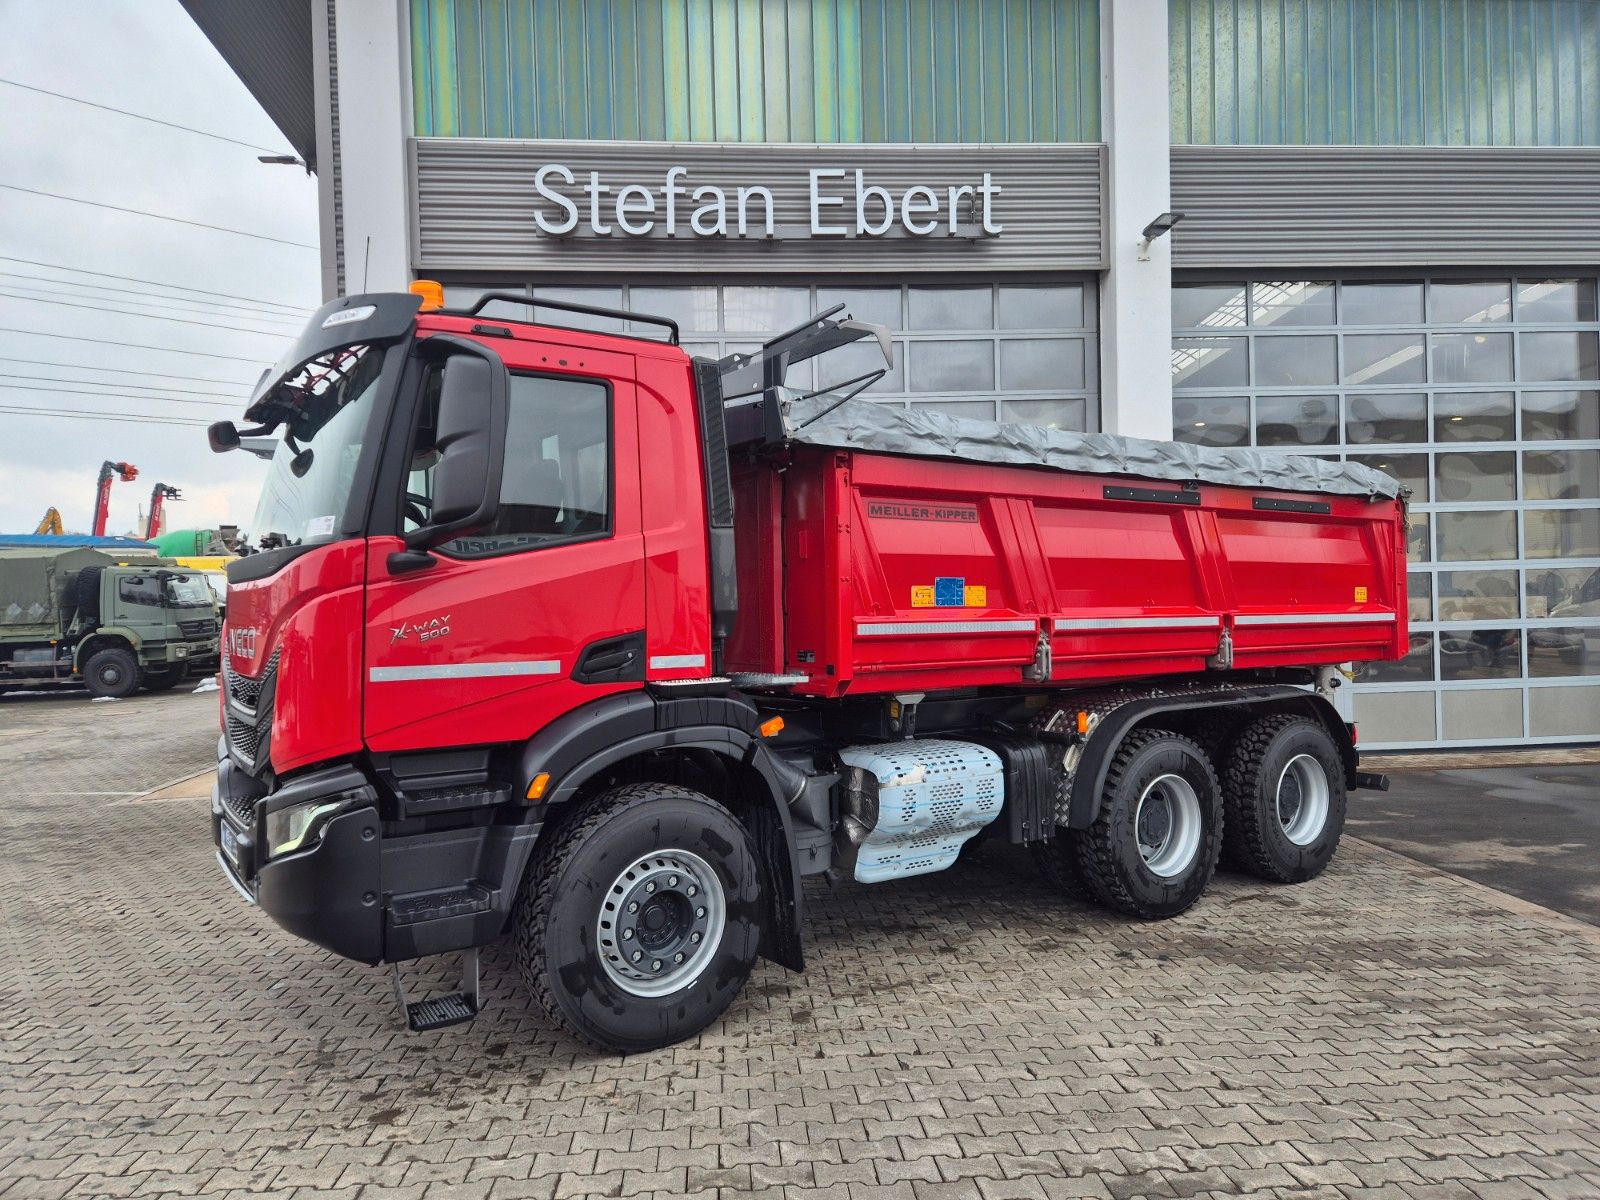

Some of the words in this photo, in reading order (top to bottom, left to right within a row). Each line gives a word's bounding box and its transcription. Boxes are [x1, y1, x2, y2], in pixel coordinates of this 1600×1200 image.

[534, 163, 775, 238] Stefan
[808, 167, 1003, 237] Ebert
[869, 504, 976, 521] MEILLER-KIPPER
[389, 613, 451, 645] X-WAY
[420, 626, 450, 642] 500
